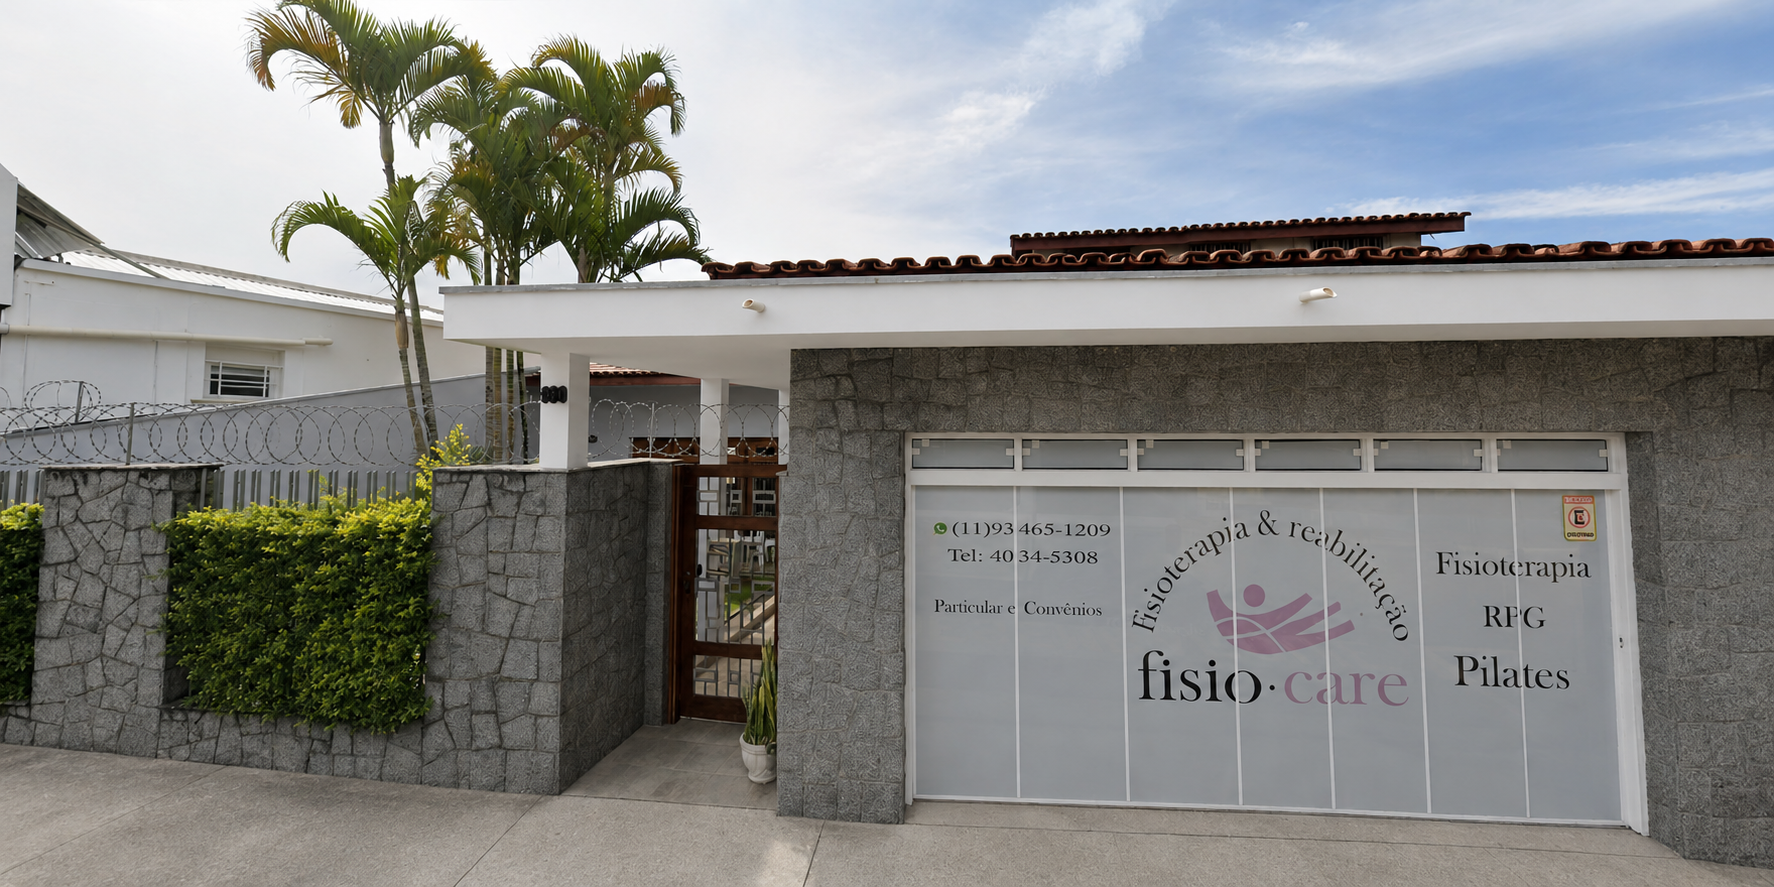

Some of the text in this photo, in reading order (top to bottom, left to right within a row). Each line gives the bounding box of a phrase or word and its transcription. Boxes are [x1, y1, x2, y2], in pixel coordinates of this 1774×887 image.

[948, 549, 983, 562] Tel:
[1436, 551, 1592, 583] Fisioterapia
[1132, 510, 1409, 642] Fisioterapia & reabilitação
[934, 599, 1103, 616] Particular e Convênios
[1483, 605, 1546, 629] RPG
[1454, 655, 1570, 690] Pilates
